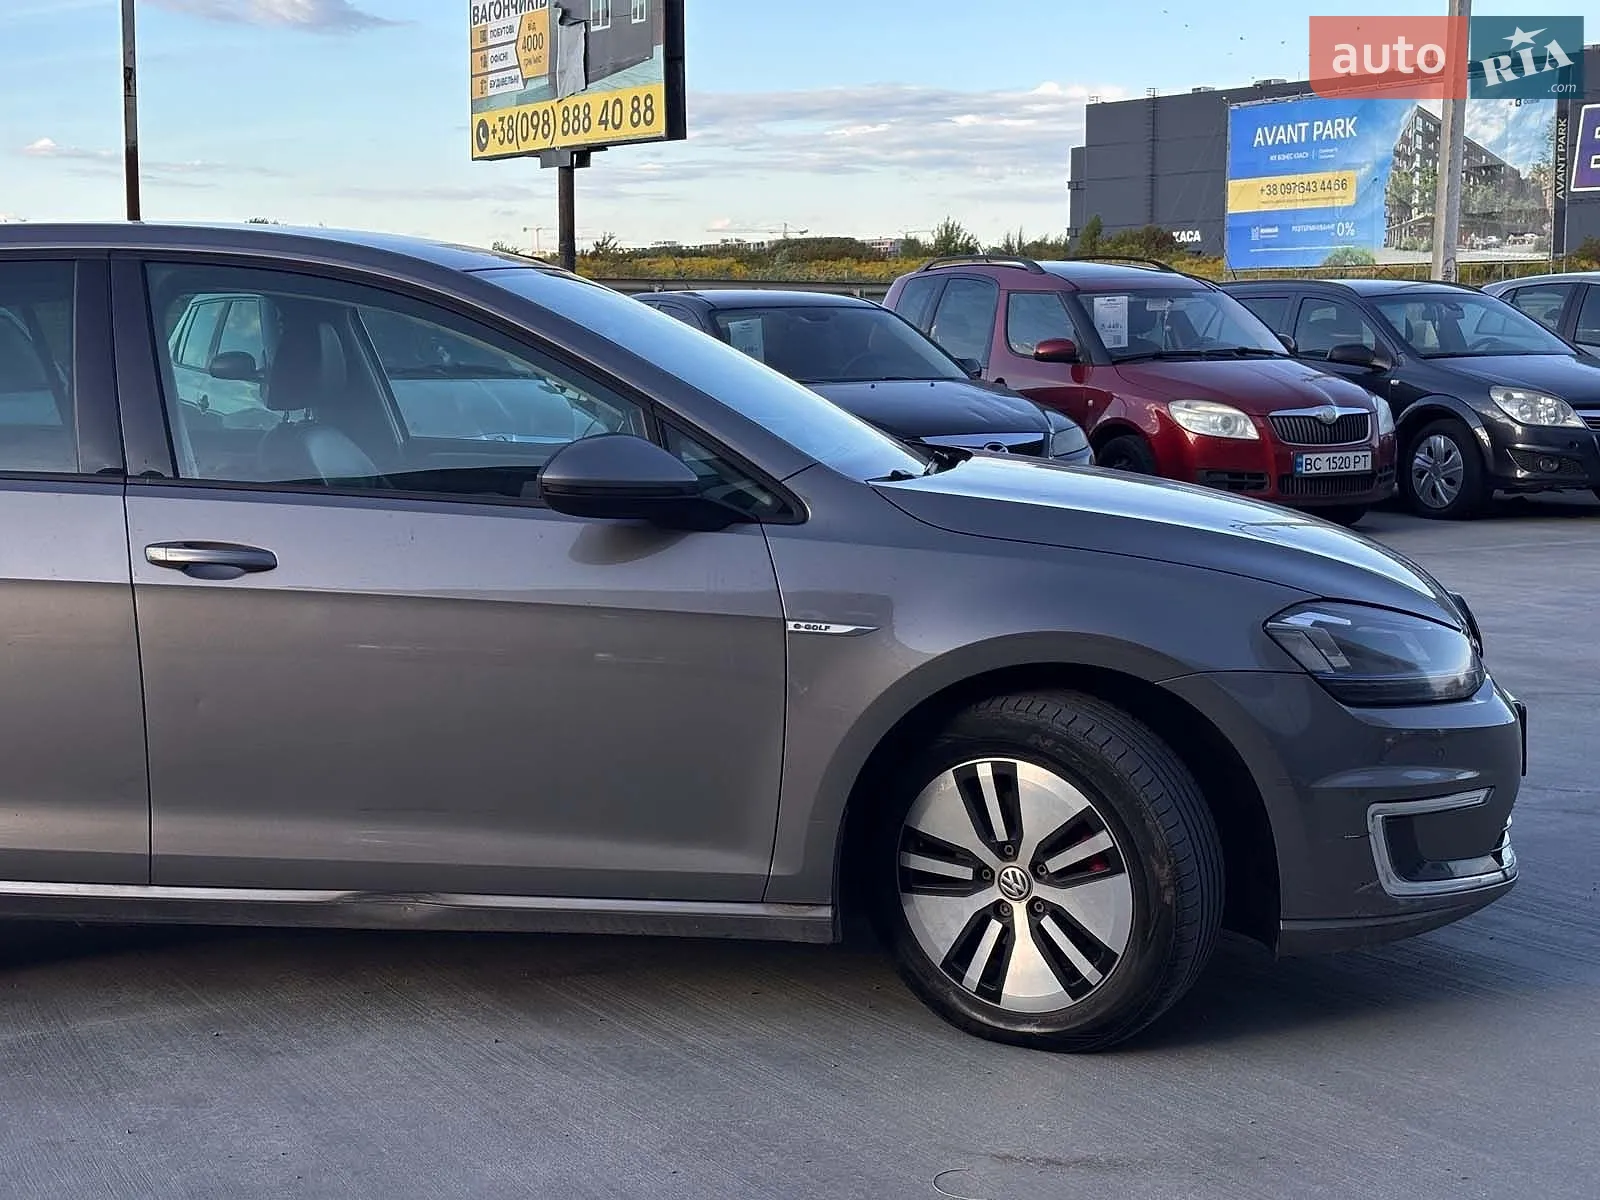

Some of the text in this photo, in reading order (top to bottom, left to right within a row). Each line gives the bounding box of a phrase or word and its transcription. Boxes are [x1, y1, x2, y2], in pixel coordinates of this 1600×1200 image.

[521, 32, 544, 53] 4000
[491, 93, 655, 150] +38(098) 888 40 88
[1253, 116, 1358, 148] AVANT PARK
[1556, 118, 1568, 200] AVANT PARK
[1336, 222, 1355, 237] 0%
[1304, 454, 1369, 472] BC 1520 PT
